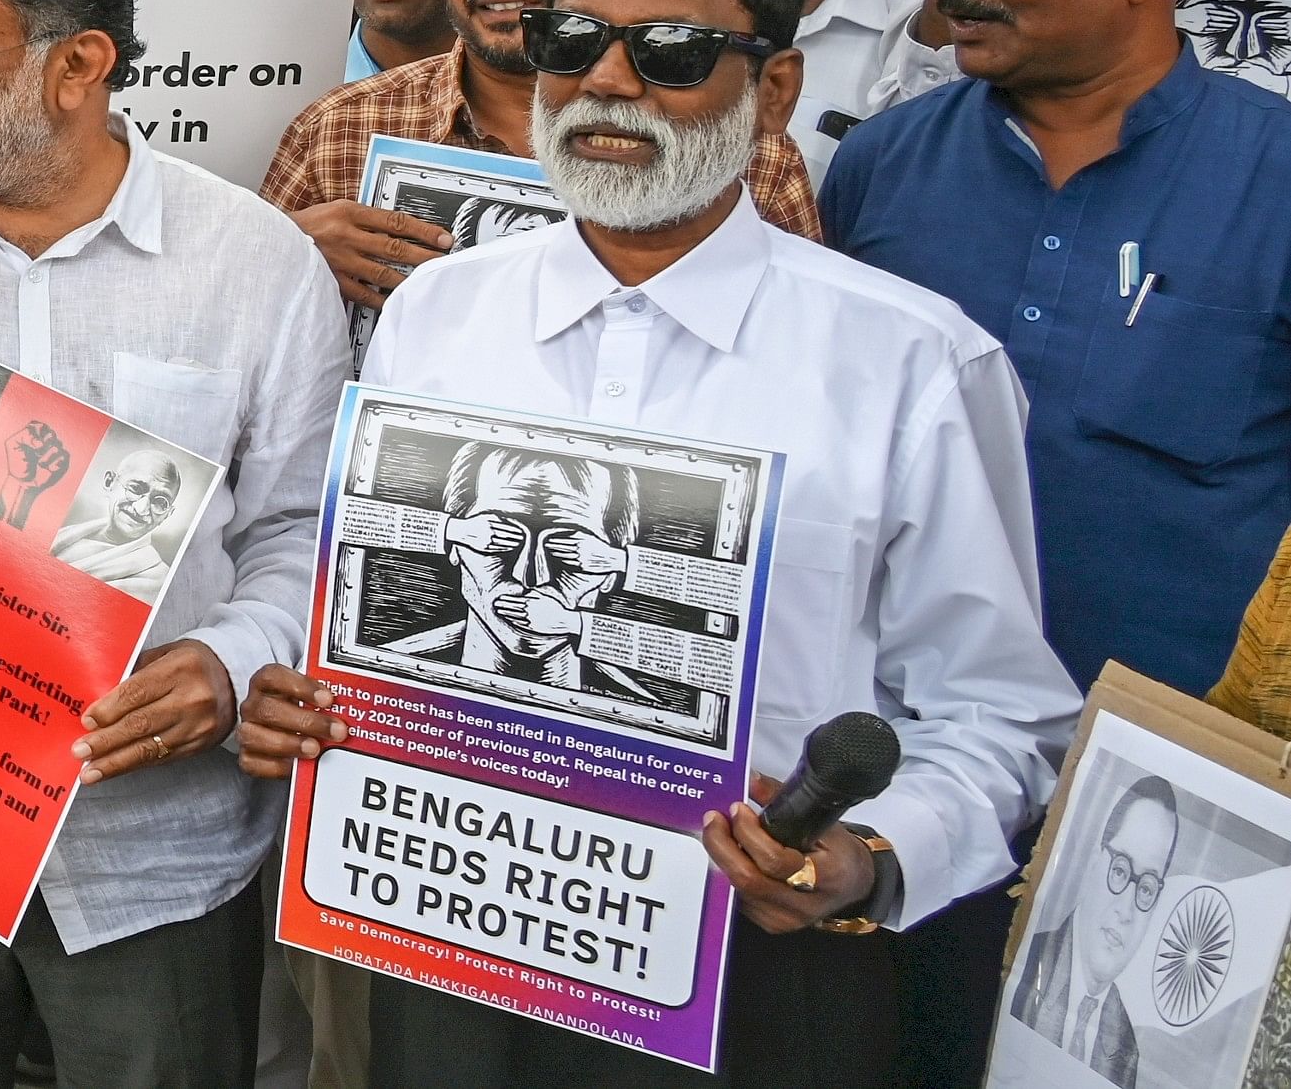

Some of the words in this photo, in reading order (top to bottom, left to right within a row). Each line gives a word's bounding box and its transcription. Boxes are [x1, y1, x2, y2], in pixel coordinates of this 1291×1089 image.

[249, 62, 301, 86] on
[172, 109, 208, 142] in
[348, 704, 365, 721] by
[368, 709, 401, 727] 2021
[405, 720, 444, 737] order
[447, 730, 463, 741] of
[465, 734, 529, 757] previous
[531, 750, 569, 767] govt.
[574, 757, 626, 781] Repeal
[630, 772, 656, 787] the
[660, 781, 704, 798] order
[348, 725, 404, 747] einstate
[407, 740, 467, 762] people's
[471, 755, 517, 774] voices
[521, 766, 568, 788] today!
[356, 688, 370, 700] to
[373, 694, 425, 713] protest
[429, 703, 452, 719] has
[456, 710, 492, 729] been
[496, 722, 543, 741] stifled
[547, 730, 560, 745] in
[565, 735, 642, 764] Bengaluru
[646, 754, 670, 770] for
[673, 764, 708, 779] over
[712, 773, 721, 783] a
[4, 795, 39, 821] and
[43, 784, 65, 801] of
[361, 777, 654, 881] BENGALURU
[342, 817, 488, 884] NEEDS
[505, 861, 665, 932] RIGHT
[343, 862, 399, 905] TO
[416, 884, 648, 979] PROTEST!
[319, 911, 354, 930] Save
[359, 923, 449, 958] Democracy!
[455, 951, 514, 978] Protect
[520, 970, 562, 992] Right
[569, 985, 585, 998] to
[591, 991, 660, 1021] Protest!
[332, 946, 413, 978] HORATADA
[418, 970, 518, 1010] HAKKIGAAGI
[523, 1003, 644, 1047] JANANDOLANA
